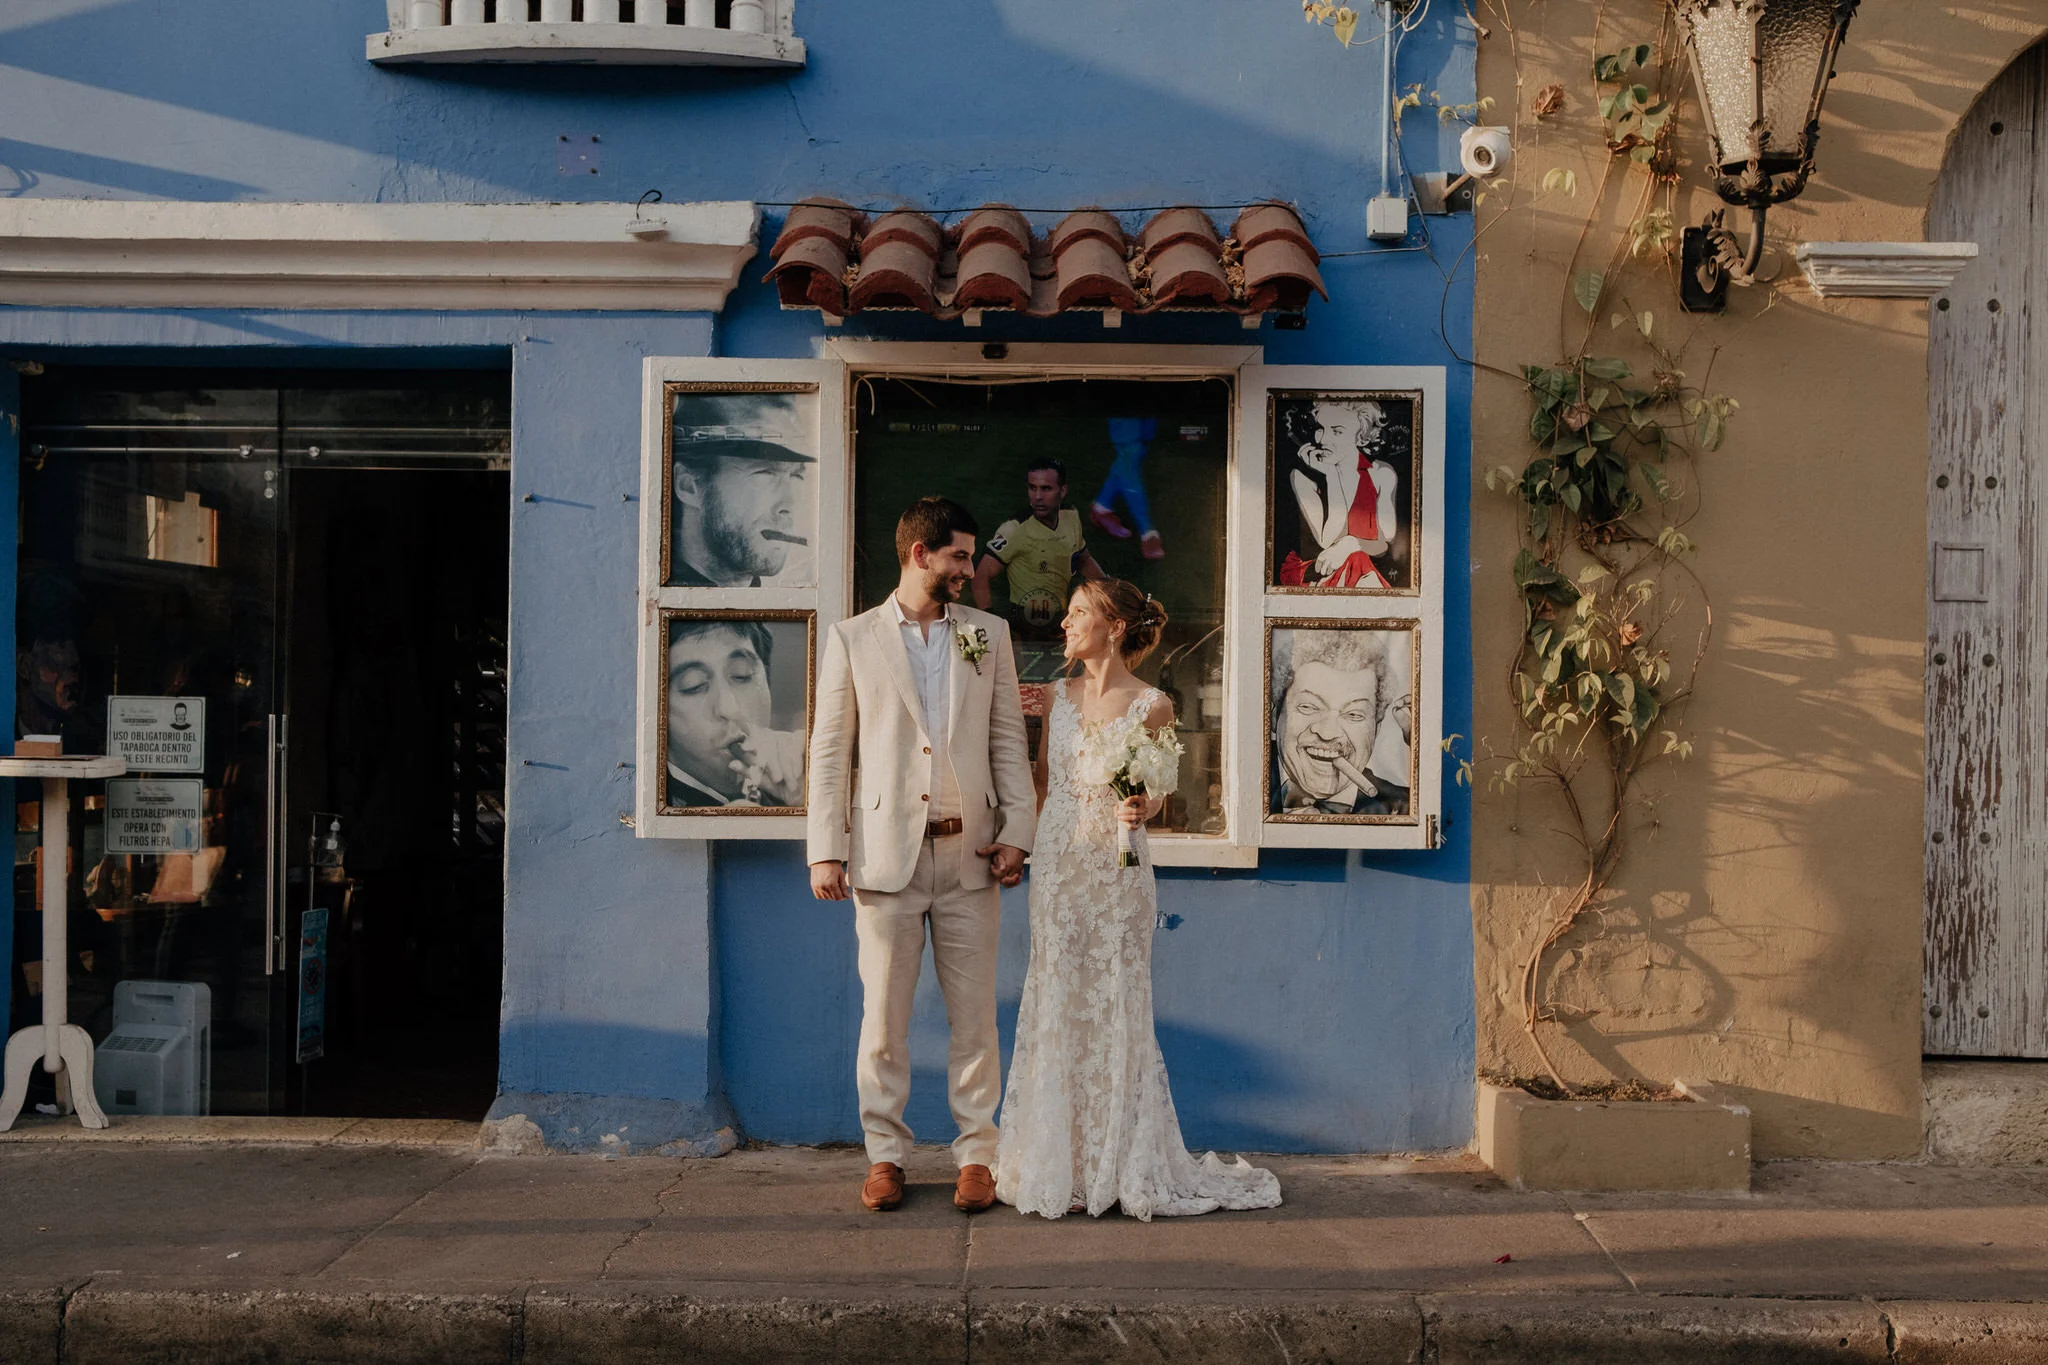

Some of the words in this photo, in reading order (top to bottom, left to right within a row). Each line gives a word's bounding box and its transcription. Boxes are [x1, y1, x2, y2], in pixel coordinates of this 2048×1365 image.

[113, 731, 128, 741] USO
[131, 731, 180, 741] OBLIGATORIO
[183, 732, 197, 742] DEL
[120, 742, 160, 752] TAPABOCA
[162, 743, 192, 753] DENTRO
[135, 754, 153, 763] ESTE
[156, 754, 188, 764] RECINTO
[111, 808, 129, 818] ESTE
[131, 808, 196, 818] ESTABLECIMIENTO
[124, 822, 149, 833] OPERA
[151, 822, 167, 833] CON
[119, 835, 149, 846] FILTROS
[151, 836, 171, 846] HEPA
